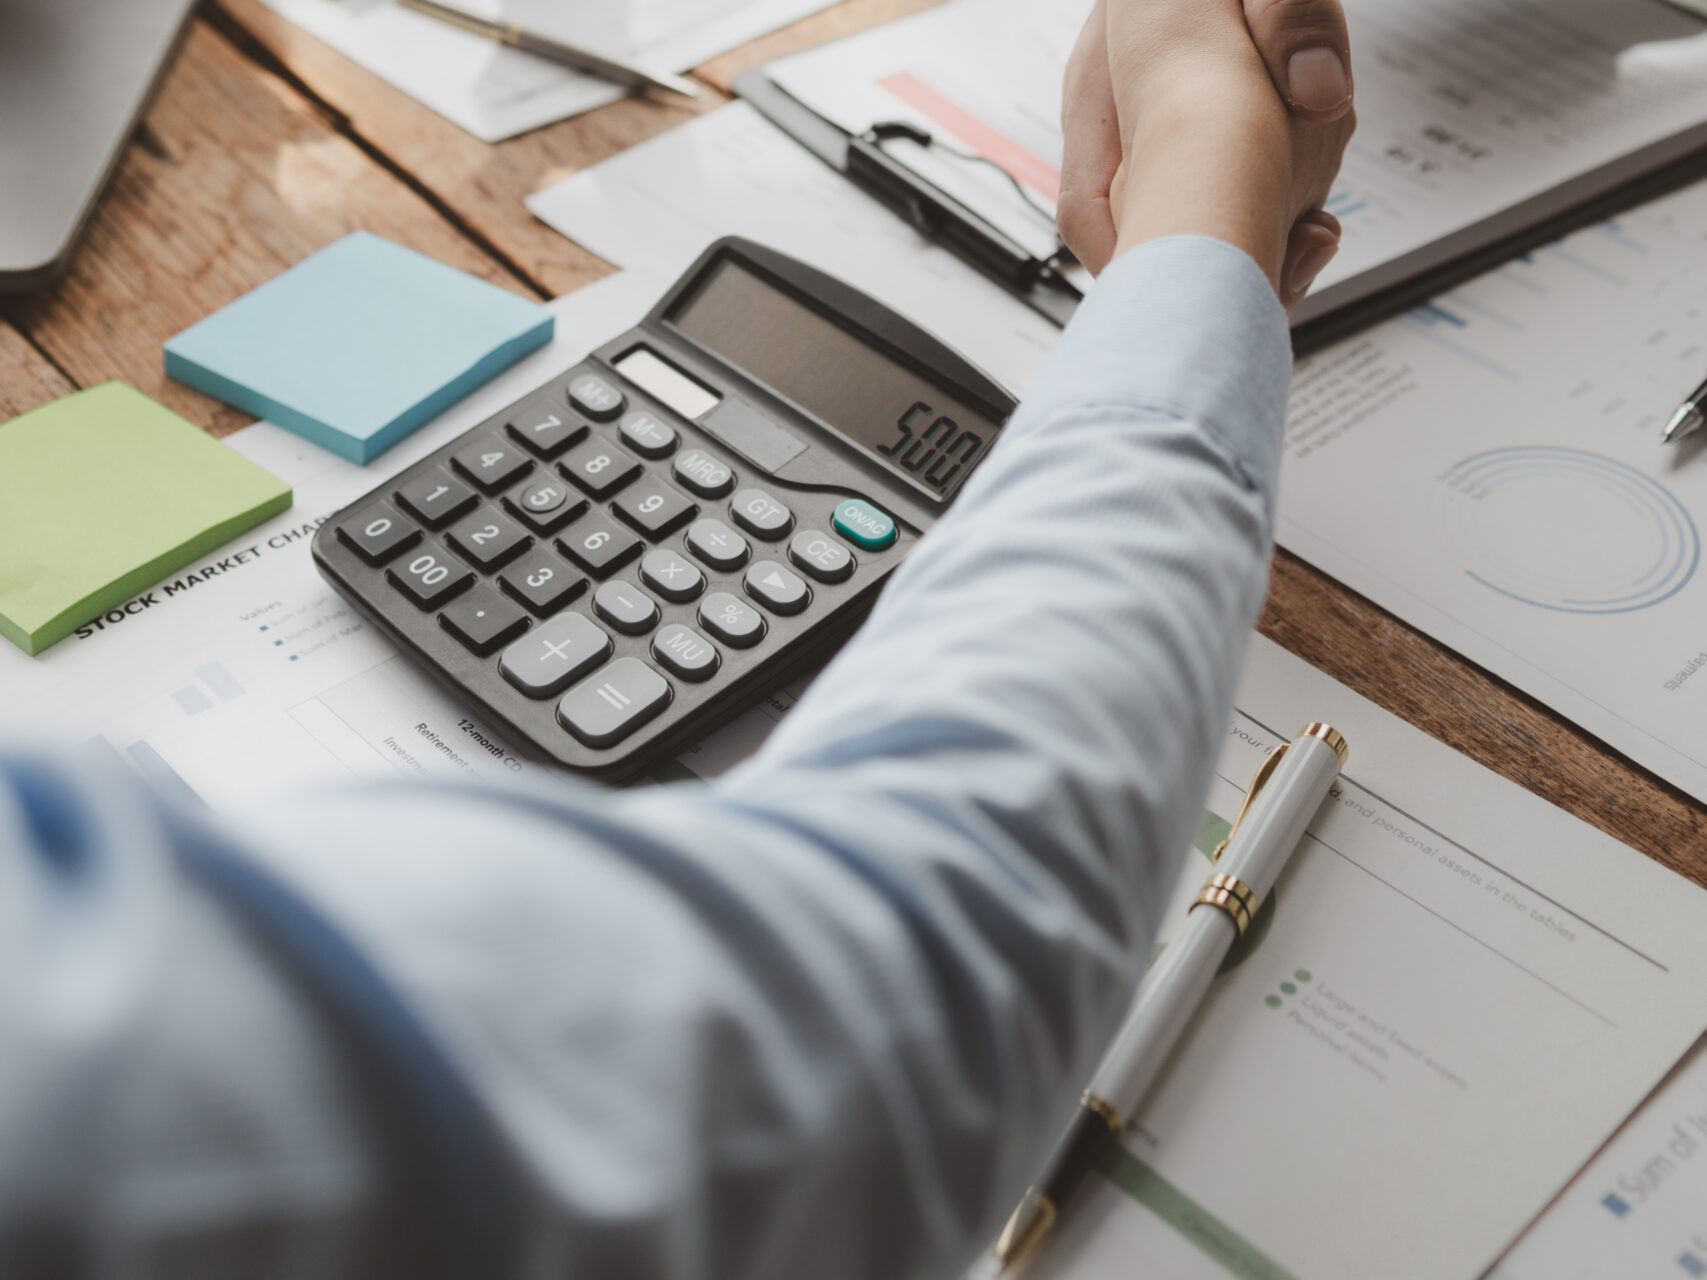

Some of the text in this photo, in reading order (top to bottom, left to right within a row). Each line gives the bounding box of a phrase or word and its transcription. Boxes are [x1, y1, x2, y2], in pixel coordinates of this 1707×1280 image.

[577, 381, 610, 406] M+
[534, 414, 562, 433] 7
[480, 450, 504, 469] 4
[585, 455, 611, 474] 8
[682, 453, 726, 486] MRC
[425, 484, 449, 503] 1
[529, 487, 558, 507] 5
[638, 494, 665, 514] 9
[746, 497, 781, 521] GT
[843, 505, 887, 536] ON/AC
[364, 518, 392, 538] 0
[470, 524, 499, 545] 2
[583, 531, 610, 550] 6
[806, 539, 841, 566] CE
[408, 555, 449, 585] 00
[526, 567, 554, 587] 3
[73, 591, 161, 640] STOCK
[162, 543, 262, 598] MARKET
[719, 603, 744, 625] %
[539, 639, 573, 662] +
[666, 632, 705, 661] MU
[596, 683, 632, 710] =
[413, 721, 470, 771] Retirement
[457, 718, 504, 760] 12-month
[1231, 726, 1264, 749] your
[1343, 798, 1377, 820] and
[1371, 815, 1440, 858] personal
[1437, 852, 1483, 888] assets
[1484, 880, 1503, 897] in
[1502, 890, 1528, 914] the
